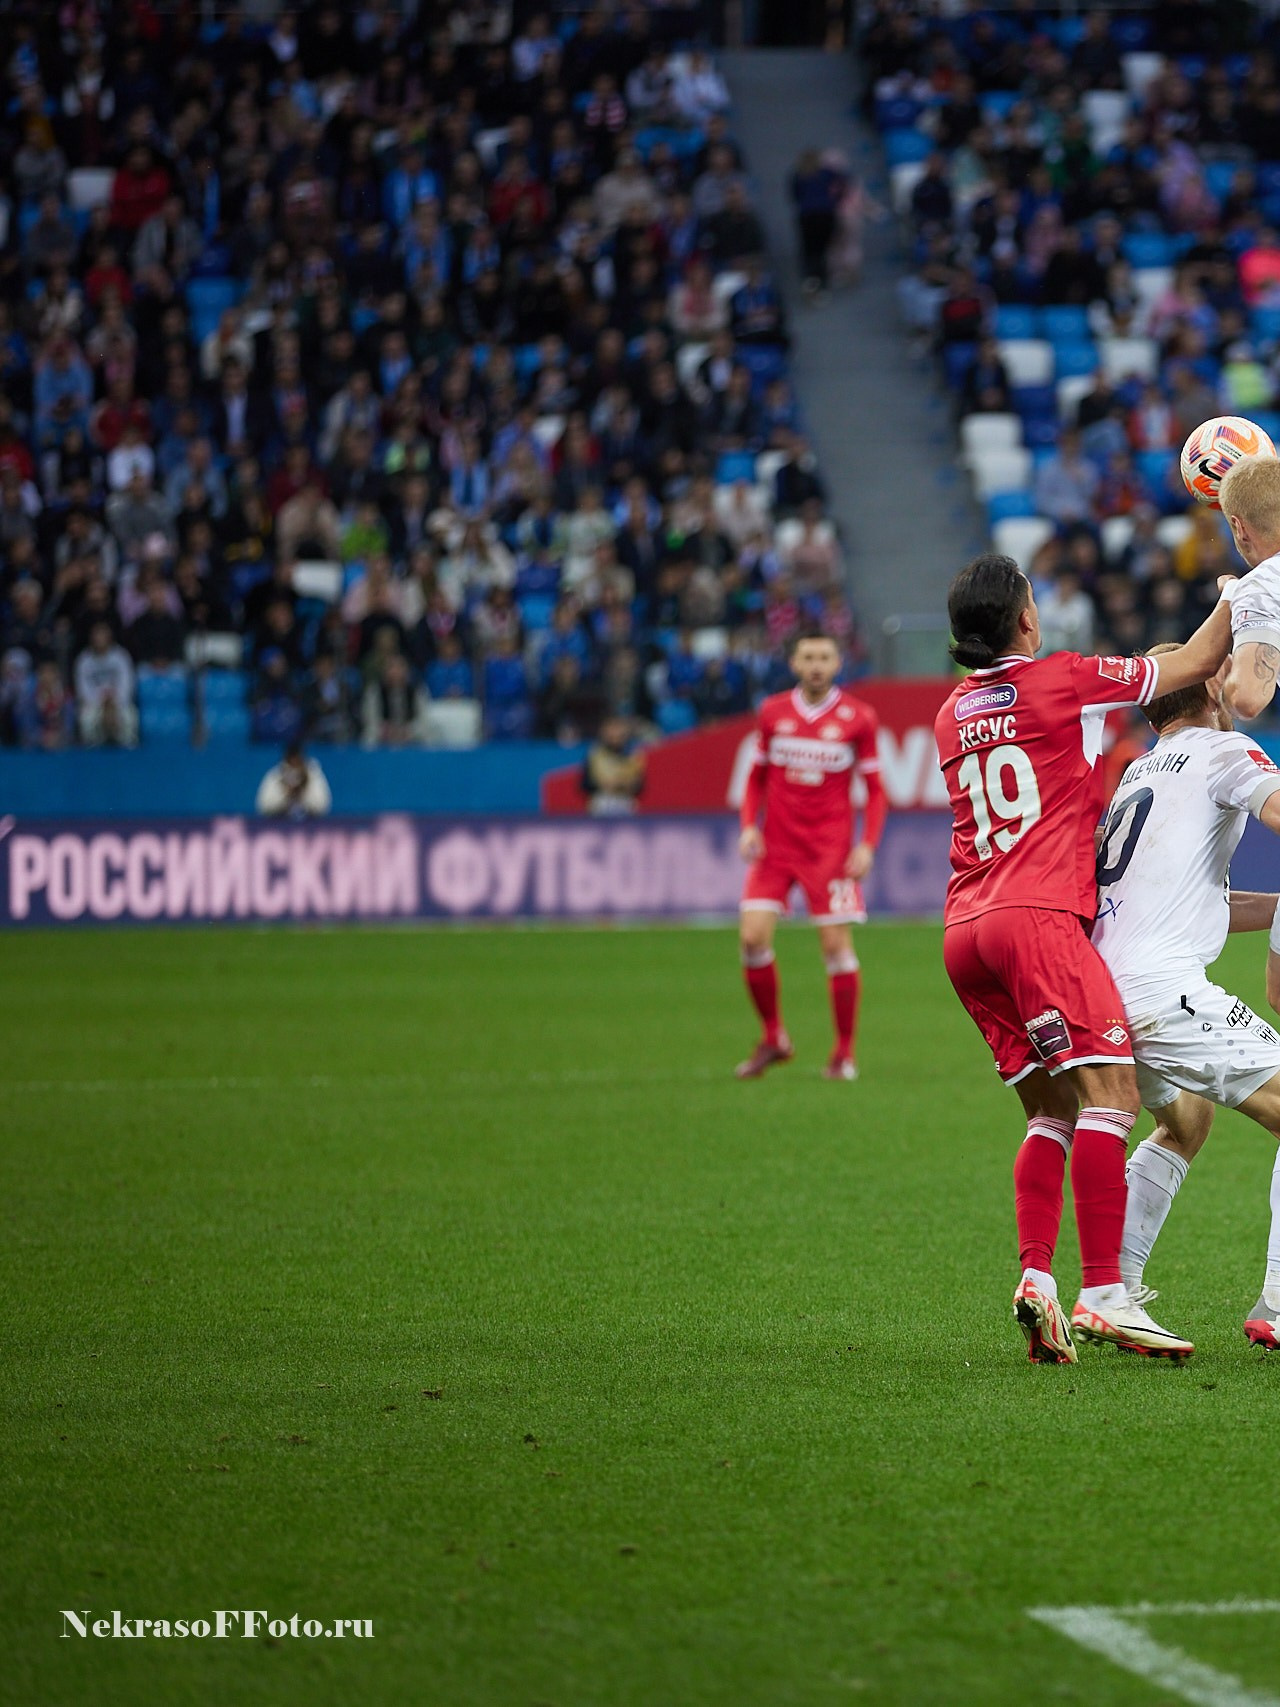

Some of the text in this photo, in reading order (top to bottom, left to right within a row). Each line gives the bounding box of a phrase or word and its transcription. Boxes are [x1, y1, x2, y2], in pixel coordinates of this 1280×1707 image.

[958, 691, 1011, 714] WILDBERRIES
[958, 714, 1017, 752] ХЕСУС
[957, 744, 1042, 862] 19
[8, 813, 744, 919] РОССИЙСКИЙ ФУТБОЛЬ
